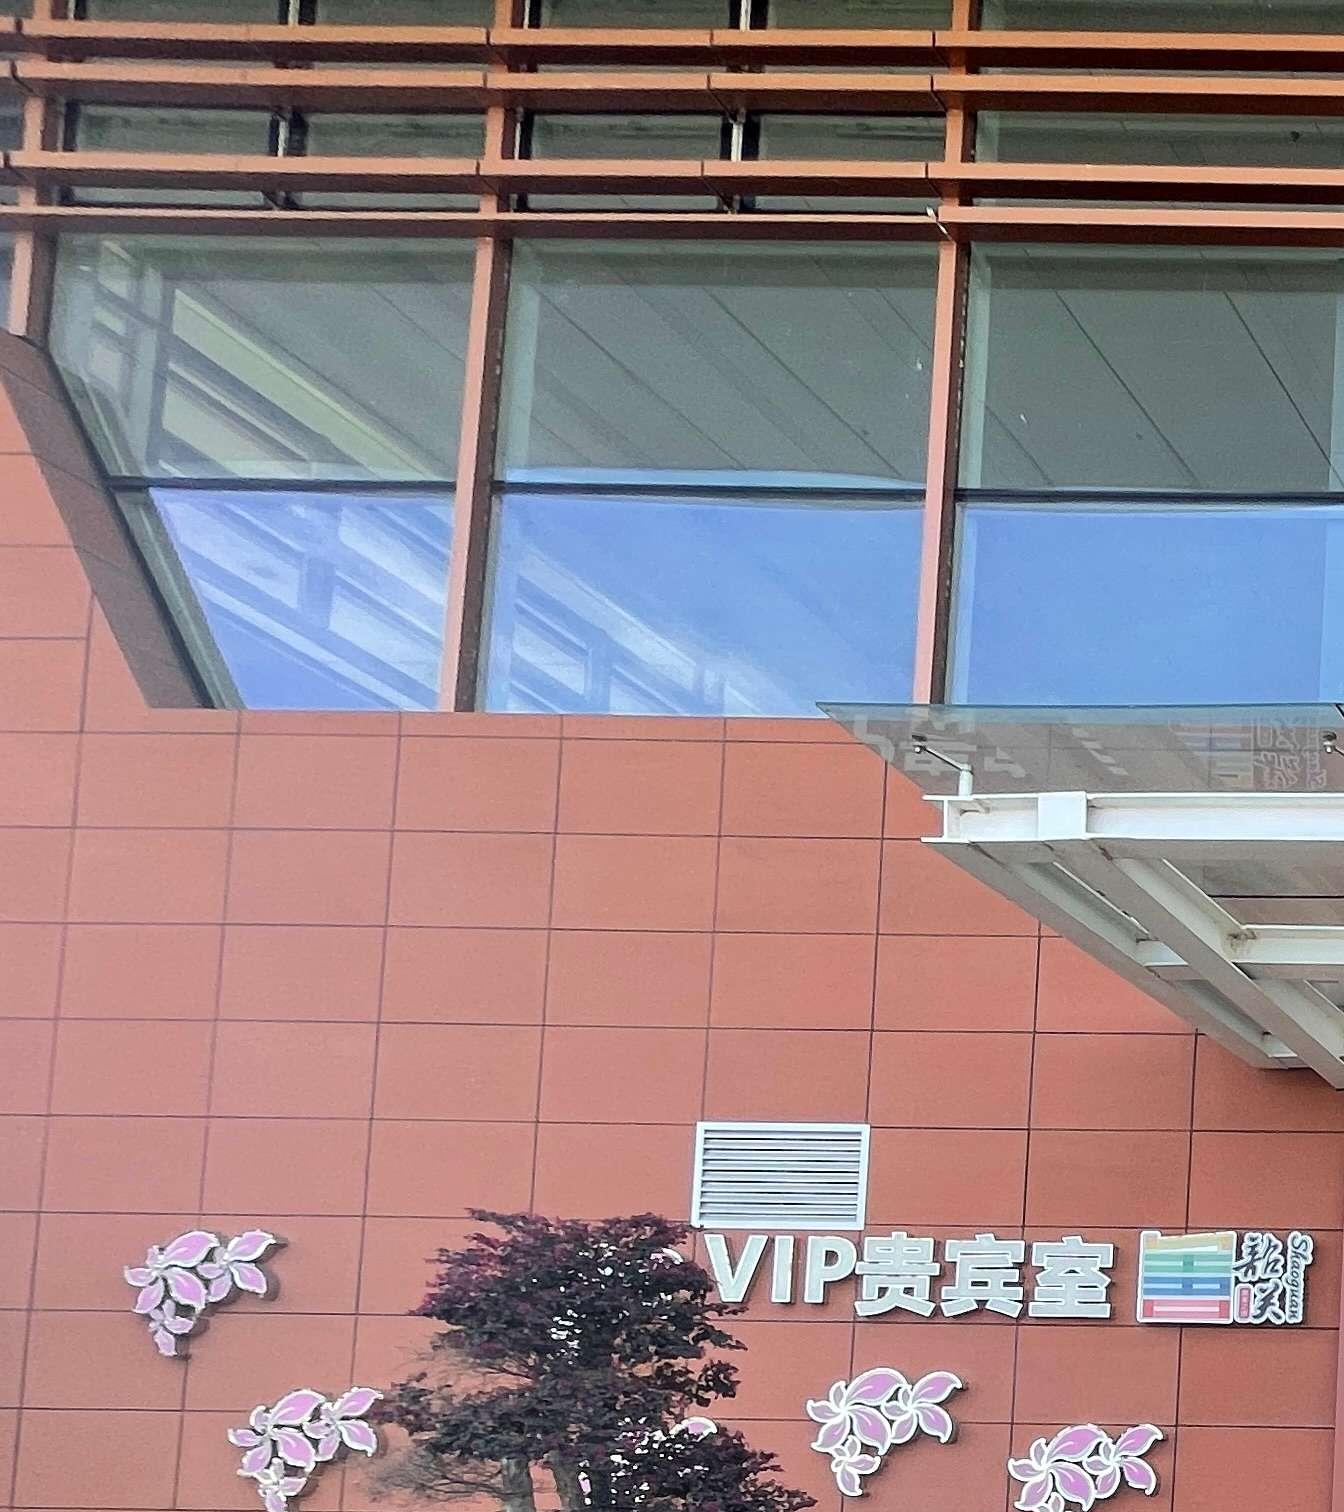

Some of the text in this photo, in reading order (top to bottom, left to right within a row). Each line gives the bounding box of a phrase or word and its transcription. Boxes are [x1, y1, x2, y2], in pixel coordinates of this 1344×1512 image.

[704, 1231, 1114, 1318] VIP贵宾室
[1284, 1232, 1313, 1322] Shaoguan
